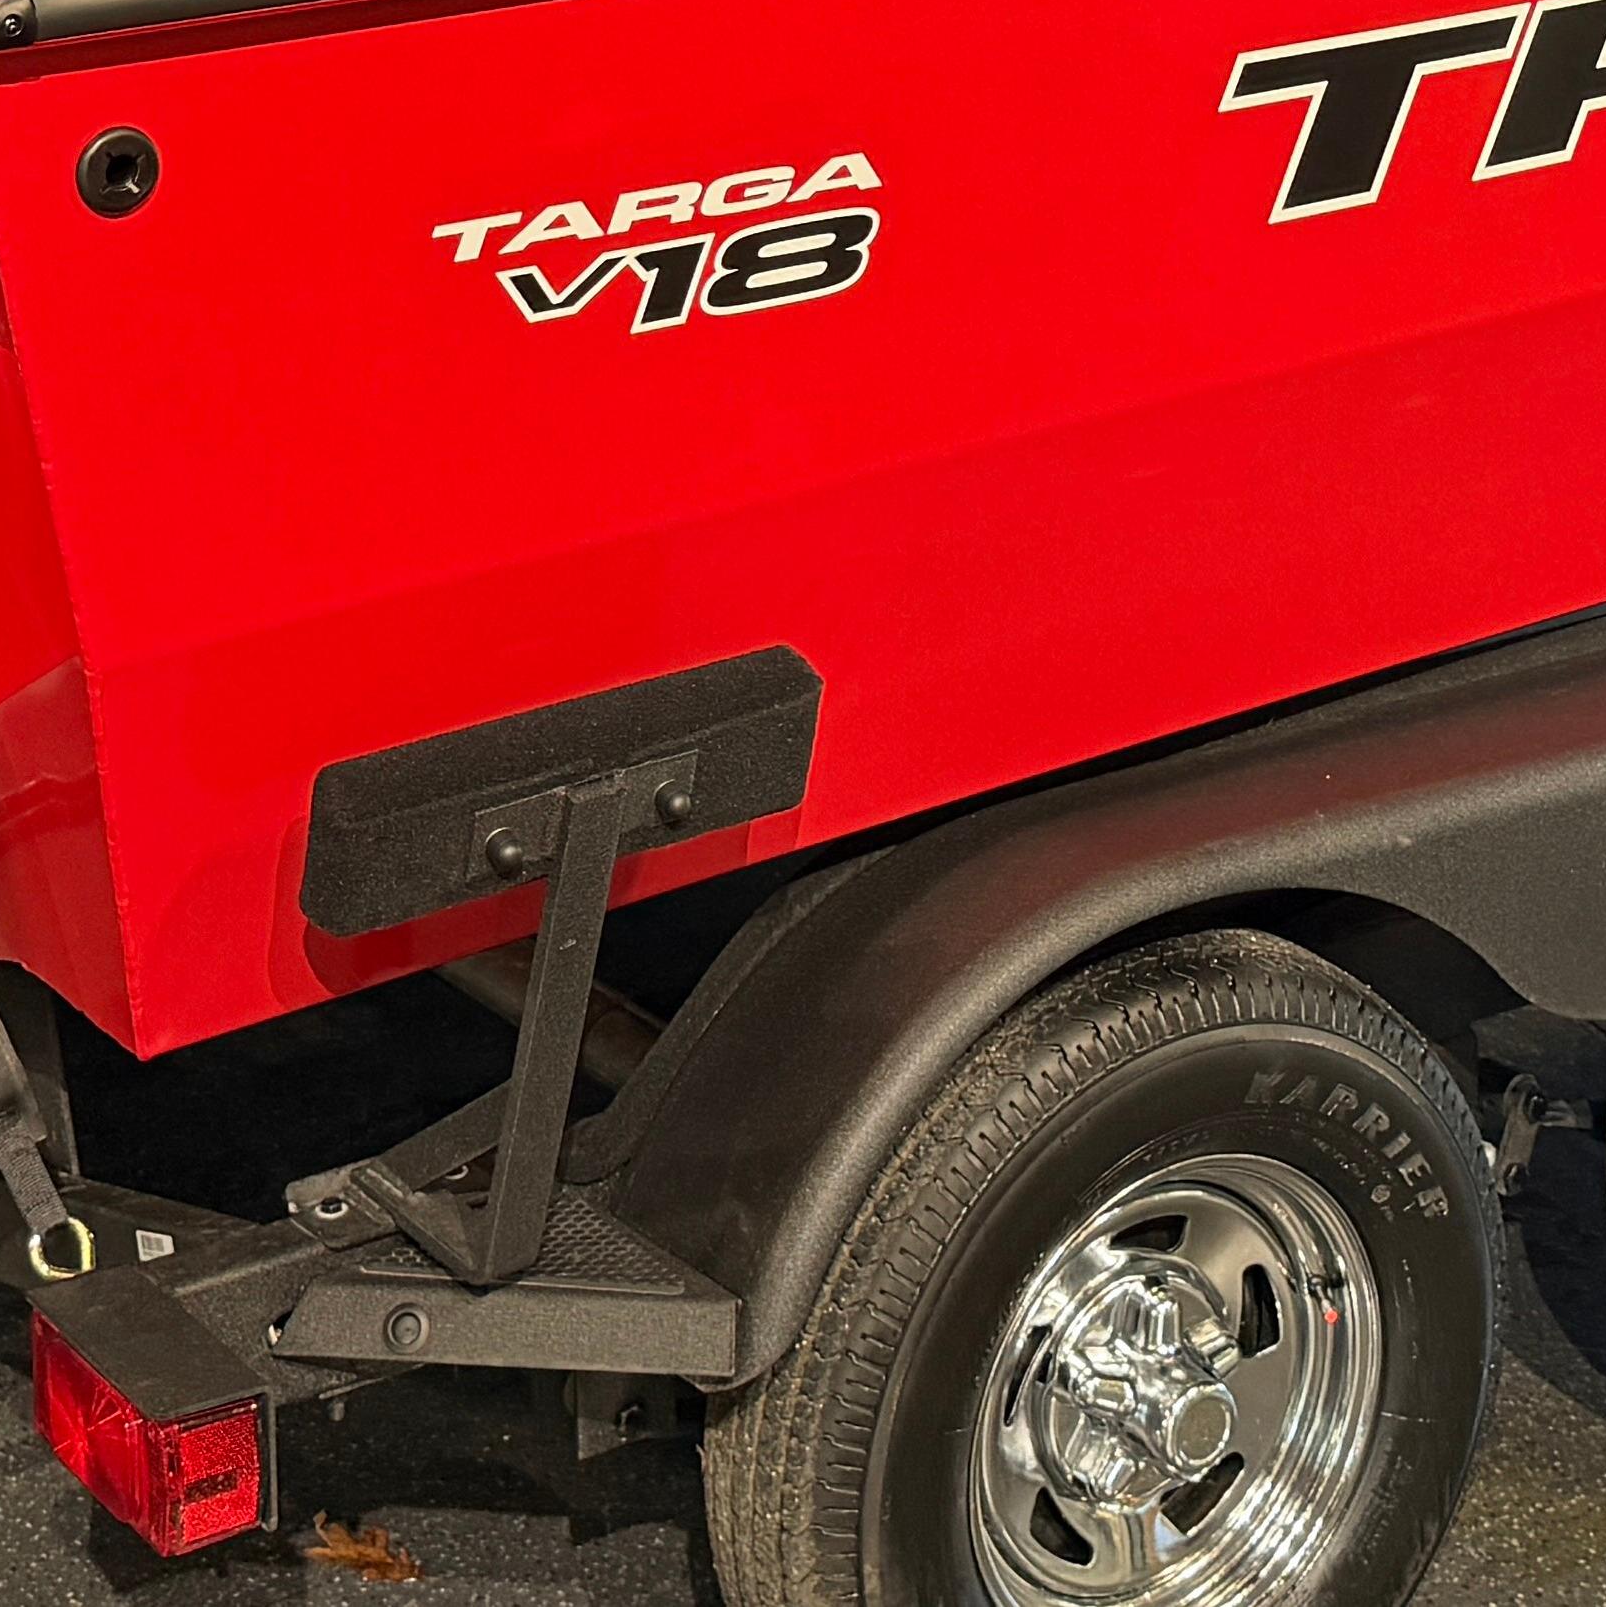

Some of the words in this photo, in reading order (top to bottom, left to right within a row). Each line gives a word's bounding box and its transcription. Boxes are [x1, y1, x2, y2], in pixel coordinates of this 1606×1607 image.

[432, 152, 883, 263] TARGA
[496, 206, 881, 335] V18
[1244, 1070, 1450, 1218] KARRIER
